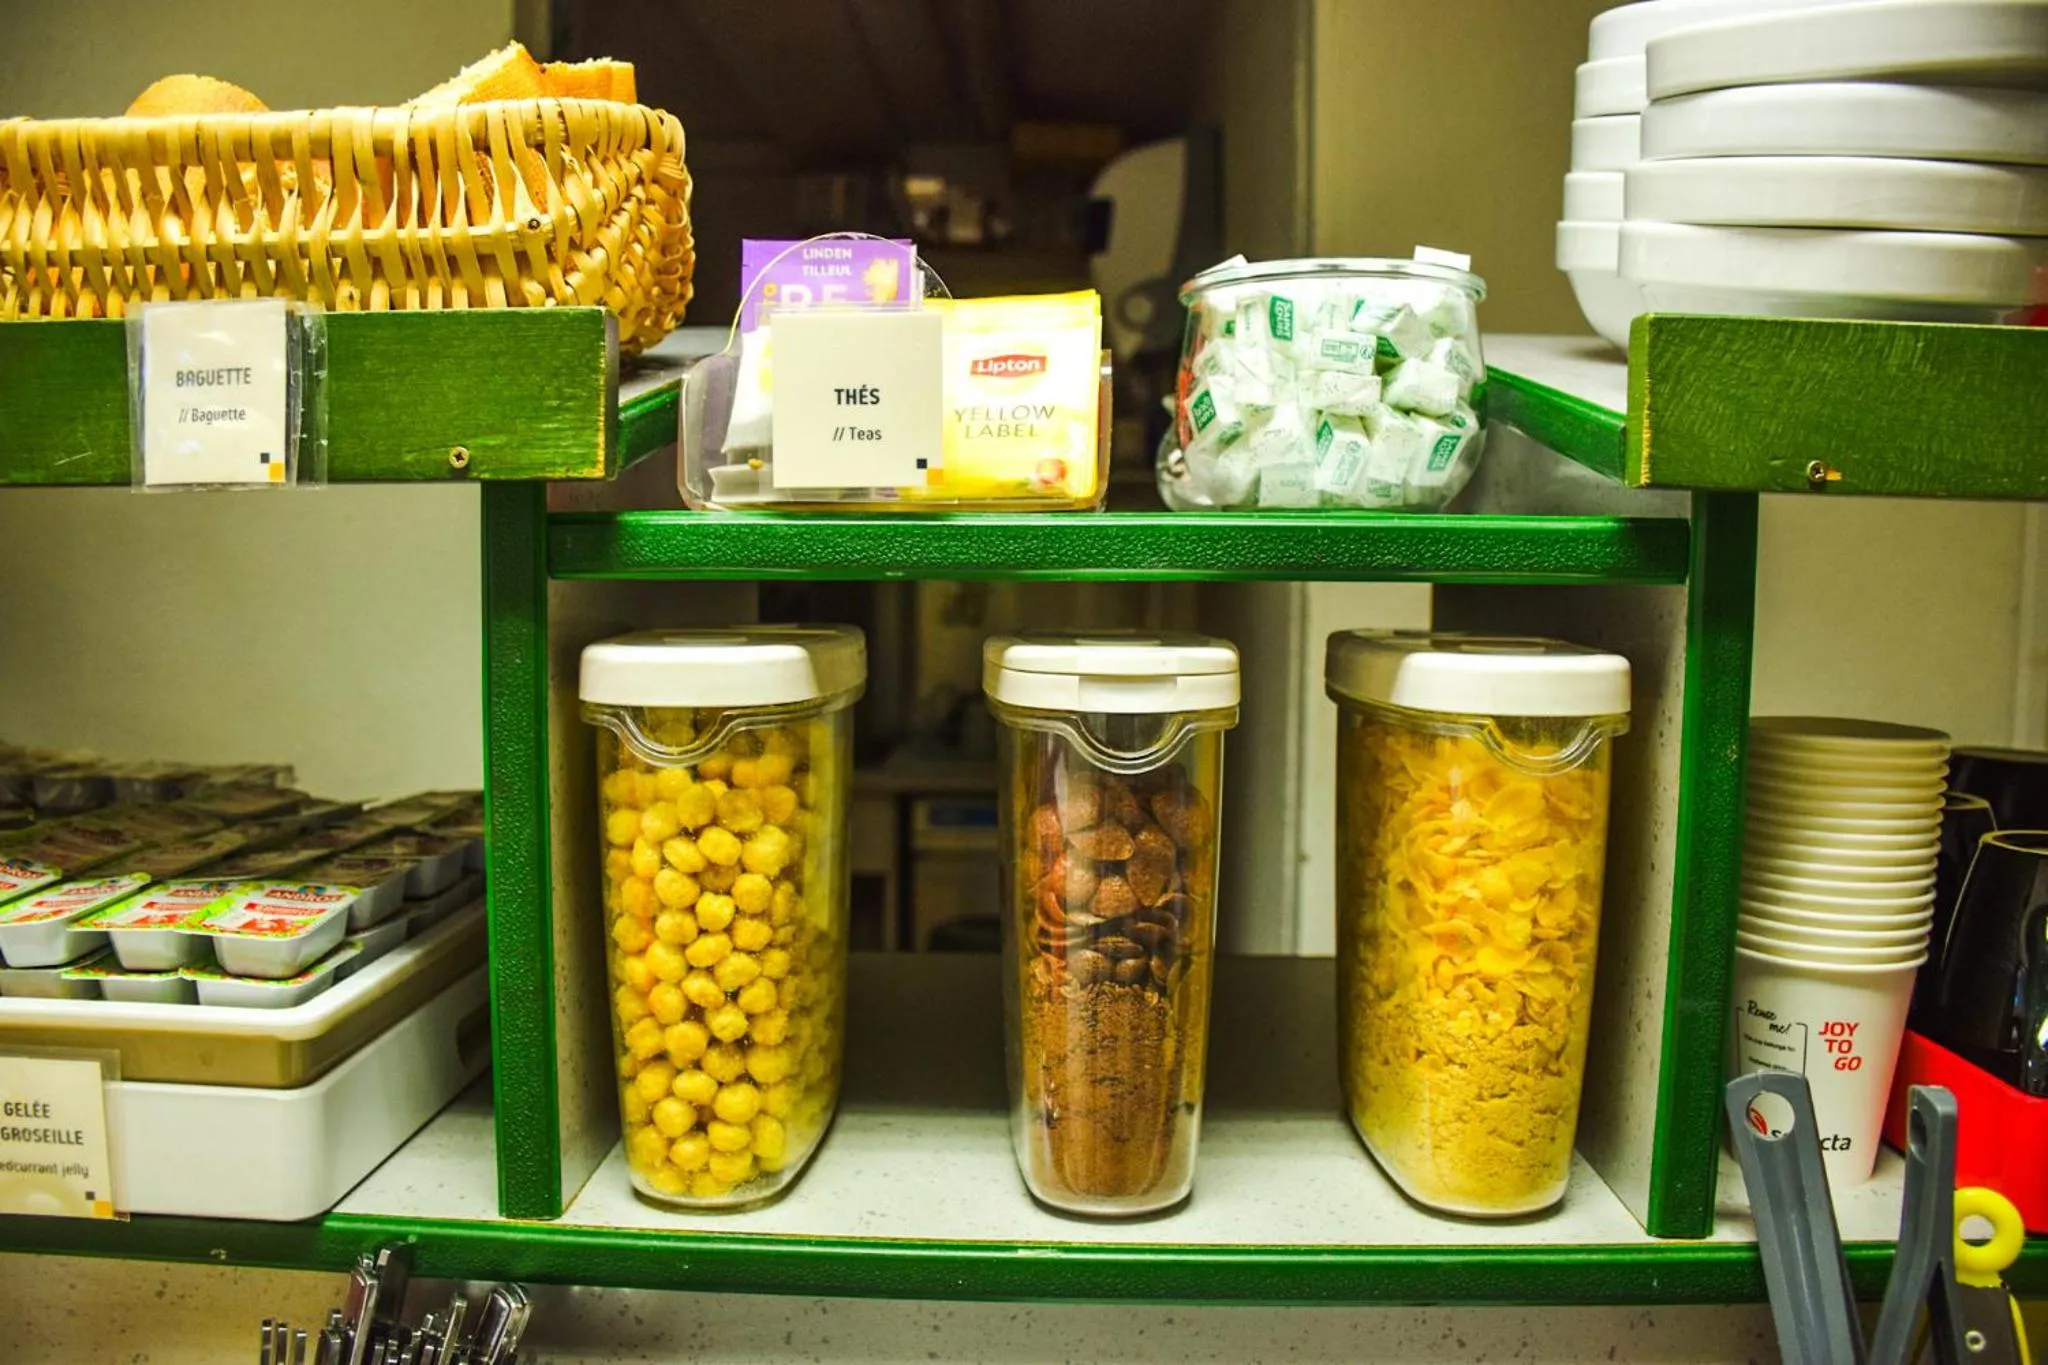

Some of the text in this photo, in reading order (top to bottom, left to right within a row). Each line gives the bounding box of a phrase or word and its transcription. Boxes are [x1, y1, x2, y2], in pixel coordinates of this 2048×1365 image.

[802, 247, 852, 260] LINDEN
[802, 264, 853, 277] TILLEUL
[976, 358, 1041, 374] Lipton
[176, 366, 252, 388] BAGUETTE
[834, 384, 880, 405] THÉS
[191, 407, 246, 425] Baguette
[954, 404, 1055, 423] YELLOW
[849, 427, 882, 441] Teas
[964, 423, 1038, 439] LABEL
[1818, 1021, 1859, 1037] JOY
[1824, 1039, 1853, 1054] TO
[1834, 1056, 1862, 1072] GO
[3, 1100, 51, 1119] GELÉE
[0, 1126, 84, 1146] GROSEILLE
[0, 1160, 89, 1180] edcurrant jelly
